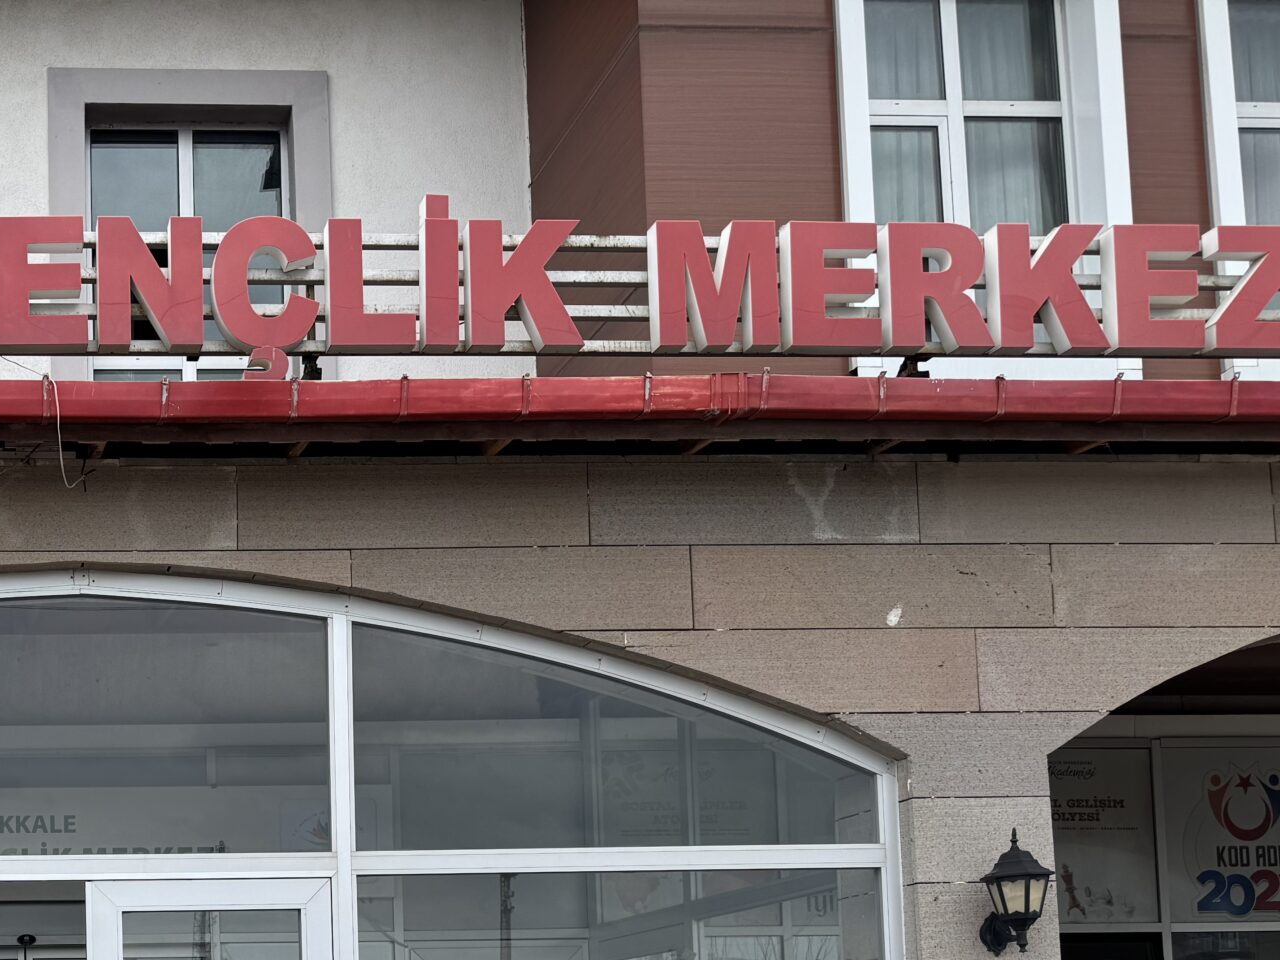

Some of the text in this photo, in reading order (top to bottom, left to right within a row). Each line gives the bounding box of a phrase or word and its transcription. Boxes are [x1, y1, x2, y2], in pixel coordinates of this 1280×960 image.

[647, 219, 1280, 356] MERKEZ
[1216, 845, 1250, 867] KOD
[1196, 868, 1280, 916] 202
